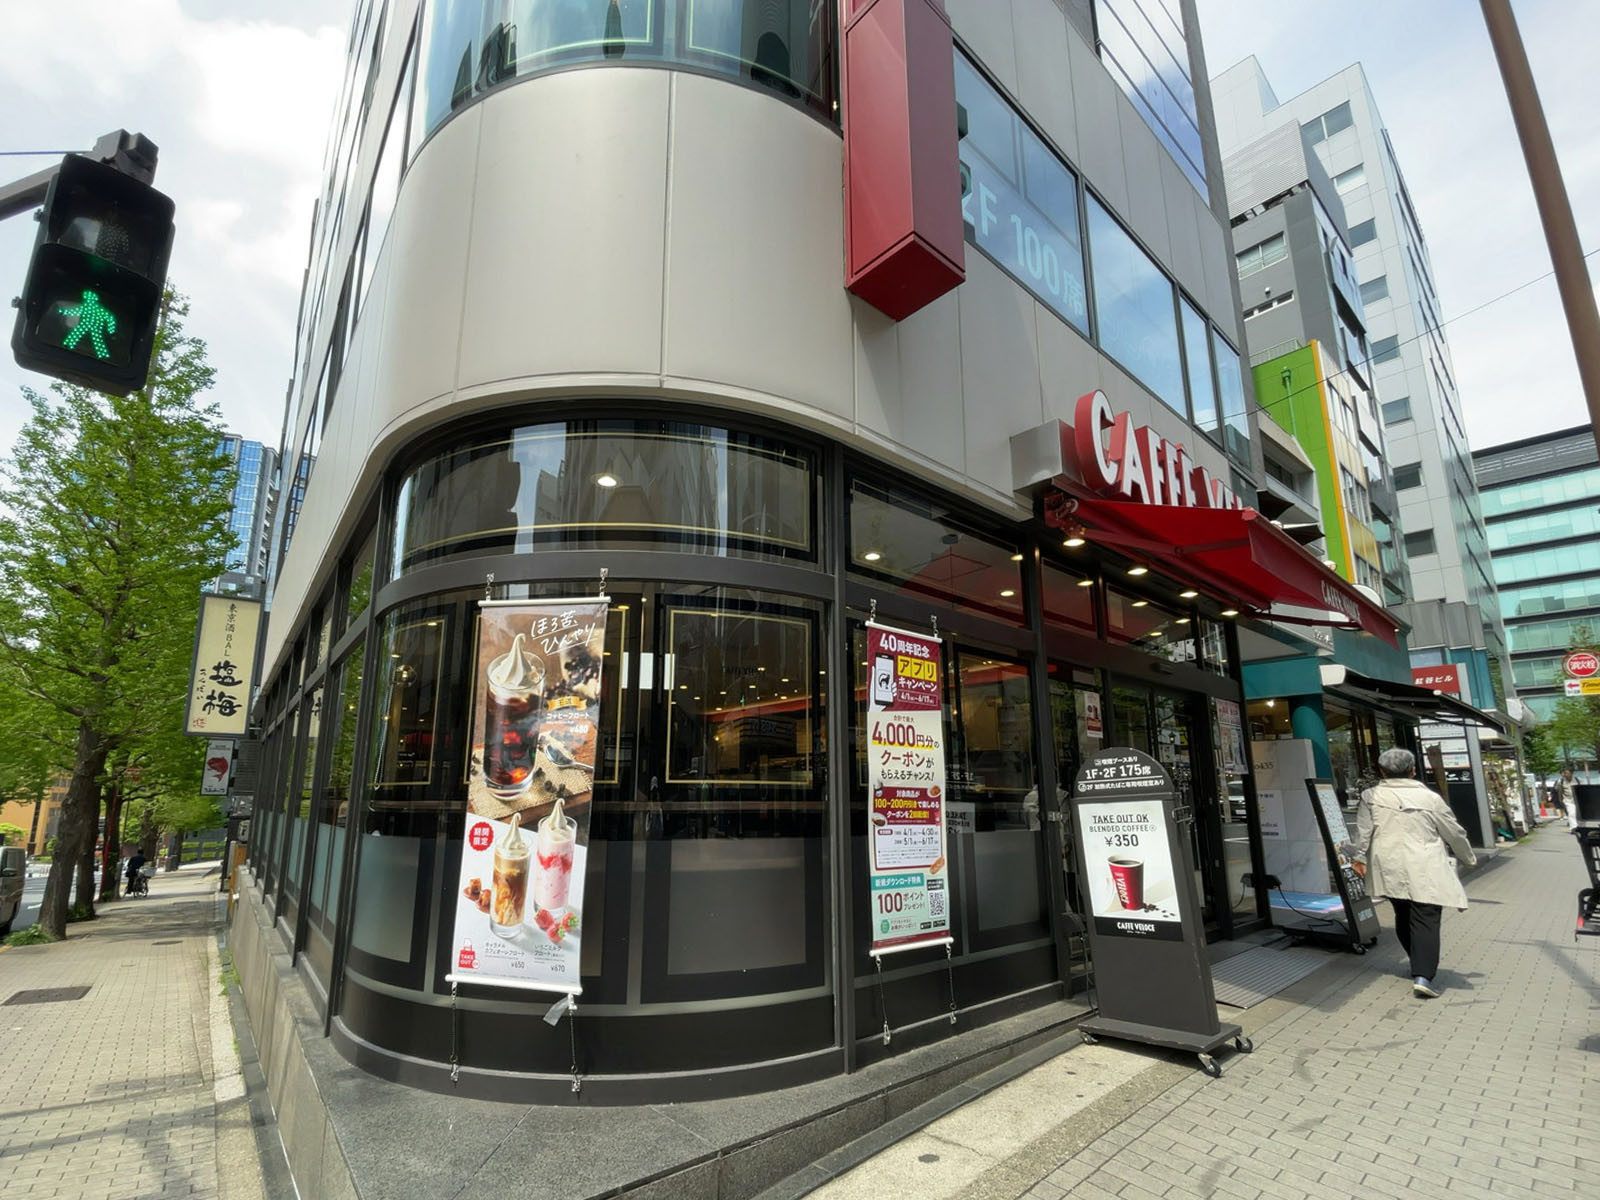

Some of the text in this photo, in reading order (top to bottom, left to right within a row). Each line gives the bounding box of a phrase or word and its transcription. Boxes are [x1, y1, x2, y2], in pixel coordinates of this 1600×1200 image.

[1010, 214, 1084, 316] 100席
[879, 633, 930, 658] 40周年記念
[899, 659, 935, 679] アプリ
[202, 660, 243, 717] 塩梅
[898, 677, 937, 692] キャンペーン
[872, 721, 940, 748] 4,000円分の
[881, 750, 934, 768] クーポンが
[1119, 764, 1151, 777] 175席
[1092, 813, 1149, 824] TAKE OUT OK
[1121, 824, 1149, 832] COFFEE
[1104, 834, 1139, 847] ¥350
[877, 891, 924, 914] 100 ポイント
[1134, 922, 1155, 932] VELOCE
